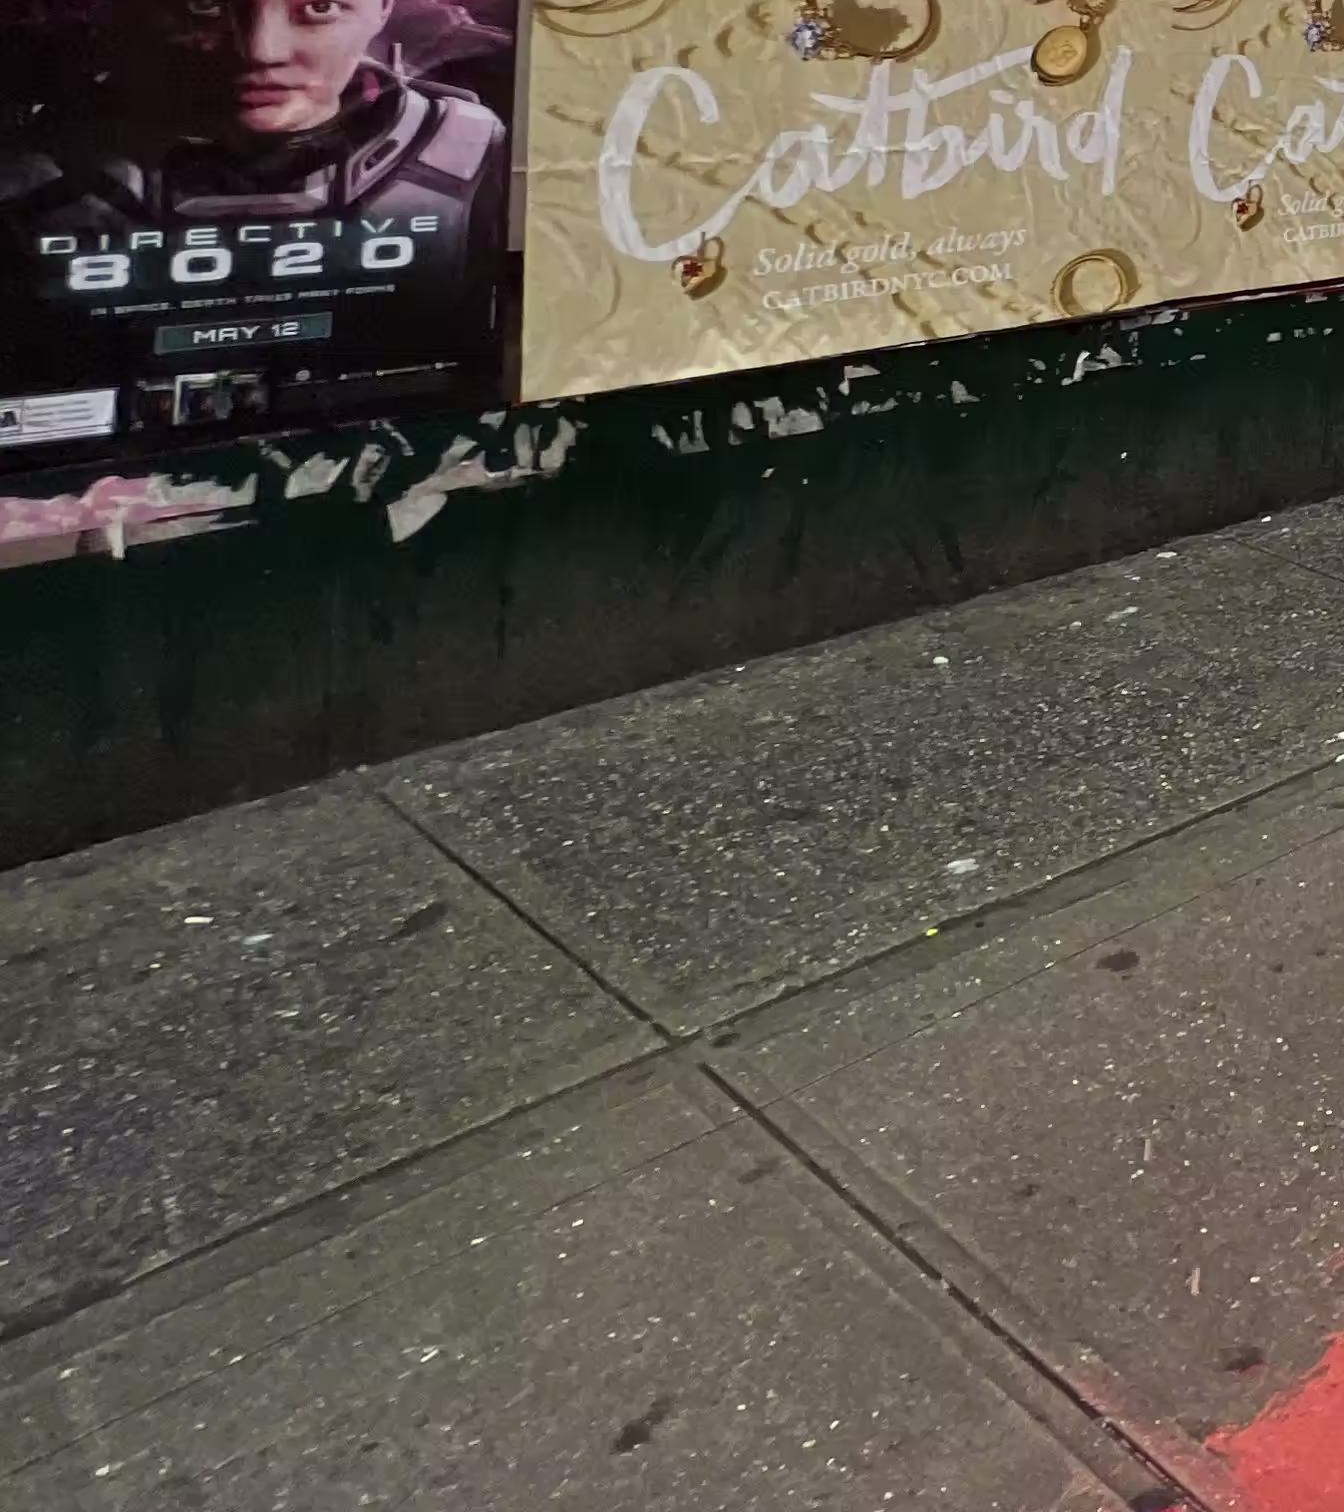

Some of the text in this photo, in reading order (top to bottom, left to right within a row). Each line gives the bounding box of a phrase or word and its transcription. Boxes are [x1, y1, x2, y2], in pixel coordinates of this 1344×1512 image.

[599, 45, 1134, 263] Catbird
[1278, 189, 1330, 216] Solid
[40, 215, 439, 254] DIRECTIVE
[754, 227, 1027, 276] Solid gold, always
[68, 236, 414, 290] 8020
[762, 263, 1013, 311] CATBIRDNYC.COM
[192, 321, 300, 344] MAY 12
